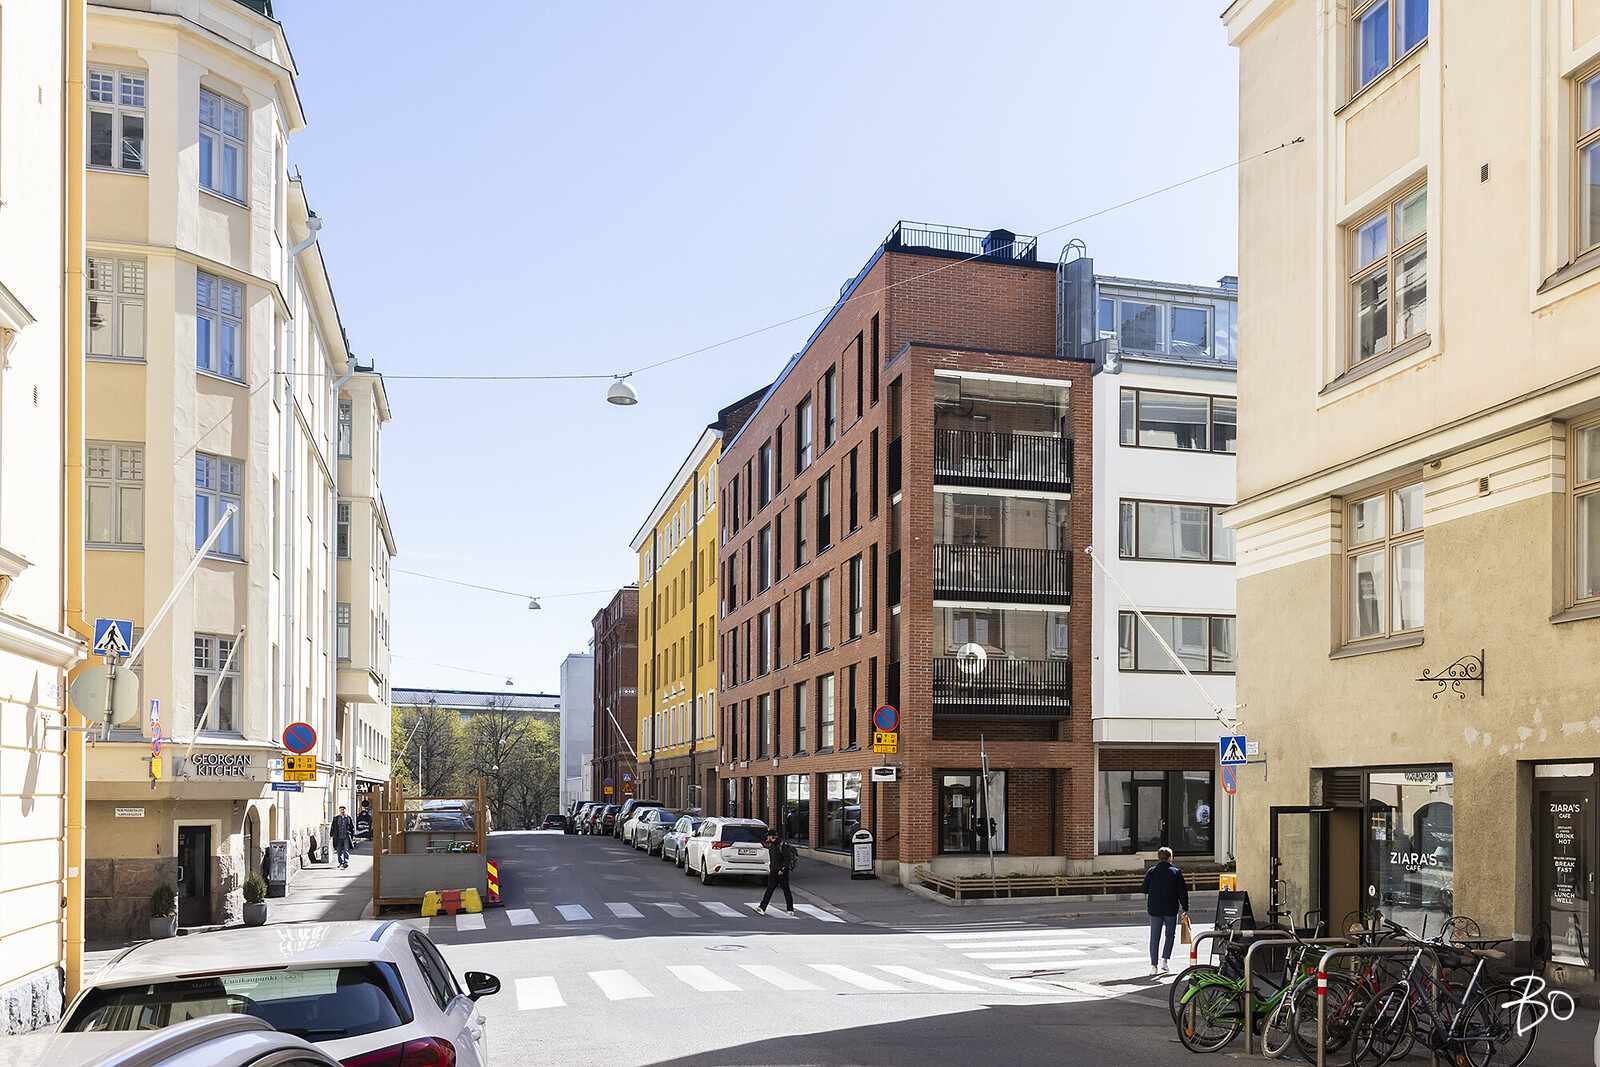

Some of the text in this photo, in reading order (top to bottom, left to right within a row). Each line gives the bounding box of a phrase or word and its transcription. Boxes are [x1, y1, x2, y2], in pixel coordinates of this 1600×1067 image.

[191, 754, 252, 765] GEORGIAN
[197, 765, 246, 776] KITCHEN
[1550, 804, 1580, 812] ZIARA'S
[1390, 852, 1437, 866] ZIARA'S
[224, 975, 278, 985] Uusikaupunki
